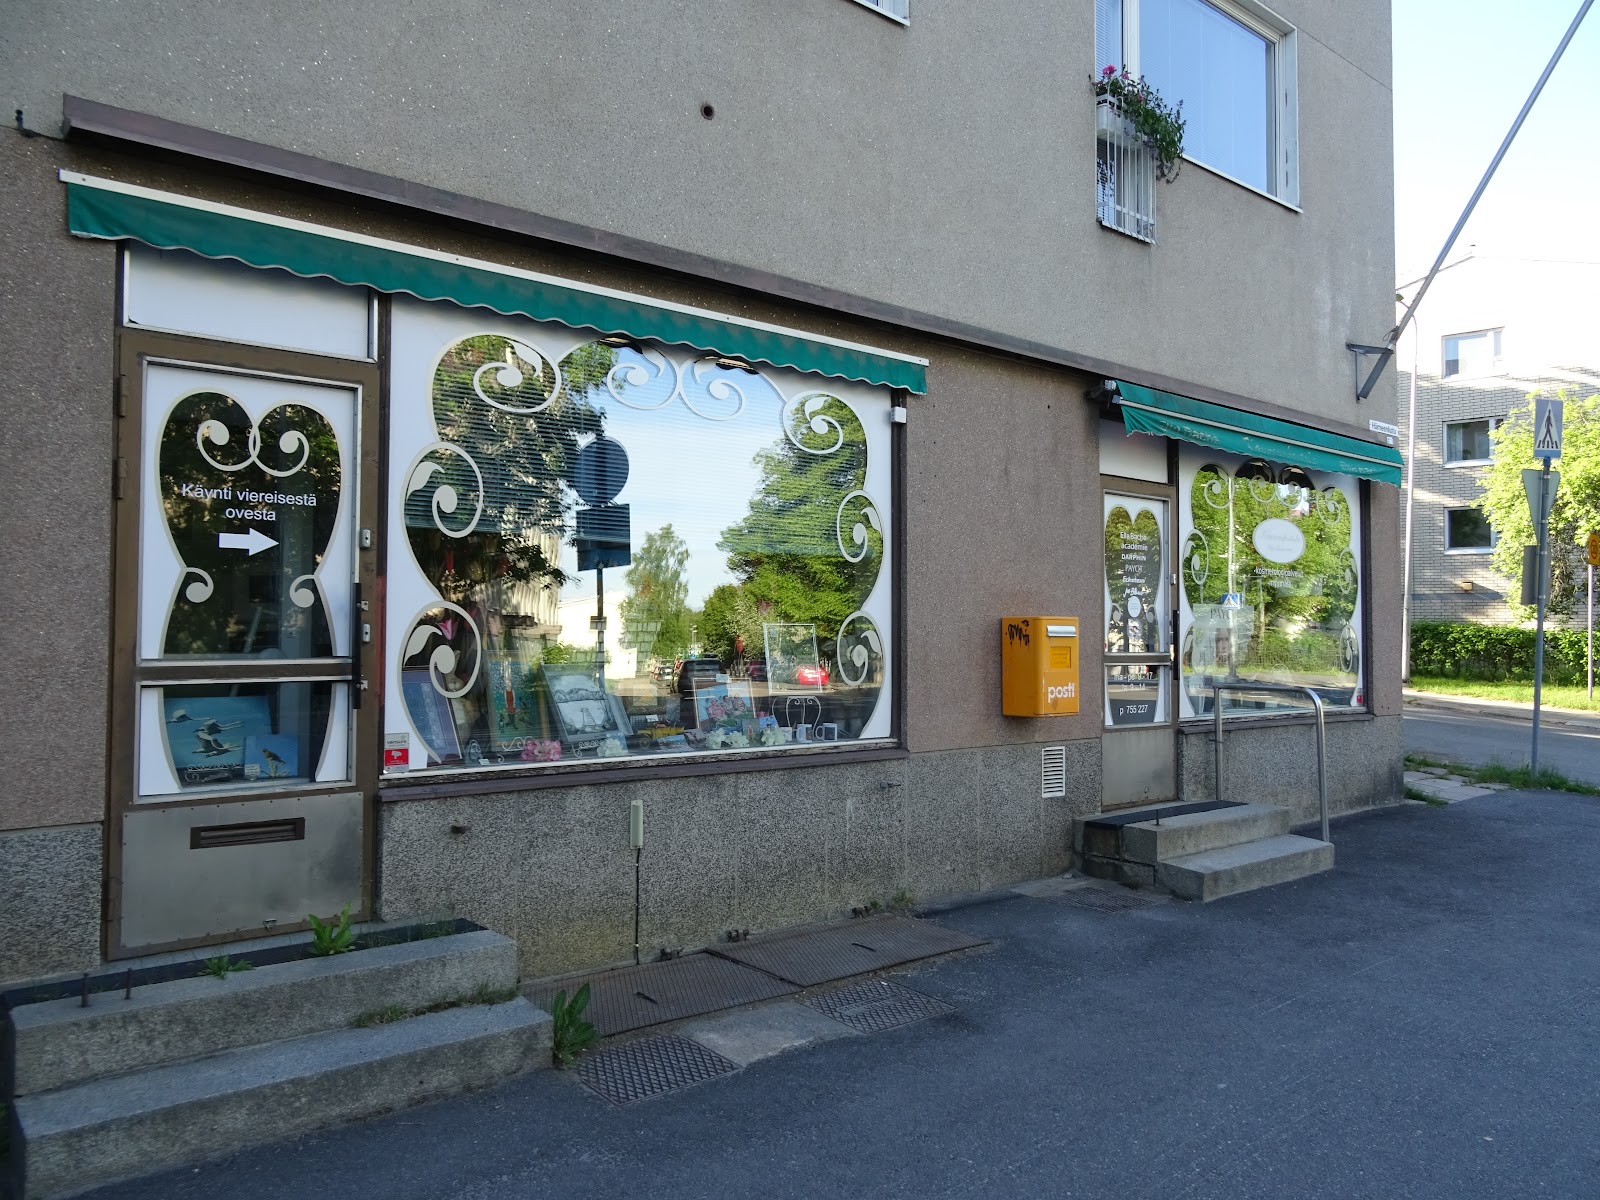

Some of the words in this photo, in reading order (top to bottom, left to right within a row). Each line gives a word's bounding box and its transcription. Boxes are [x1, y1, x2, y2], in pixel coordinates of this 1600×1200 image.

[181, 483, 232, 501] Käynti
[236, 488, 317, 507] viereisestä
[225, 507, 276, 521] ovesta
[1047, 682, 1076, 704] posti
[1119, 707, 1124, 716] p
[1126, 704, 1137, 714] 755
[1137, 704, 1148, 713] 227
